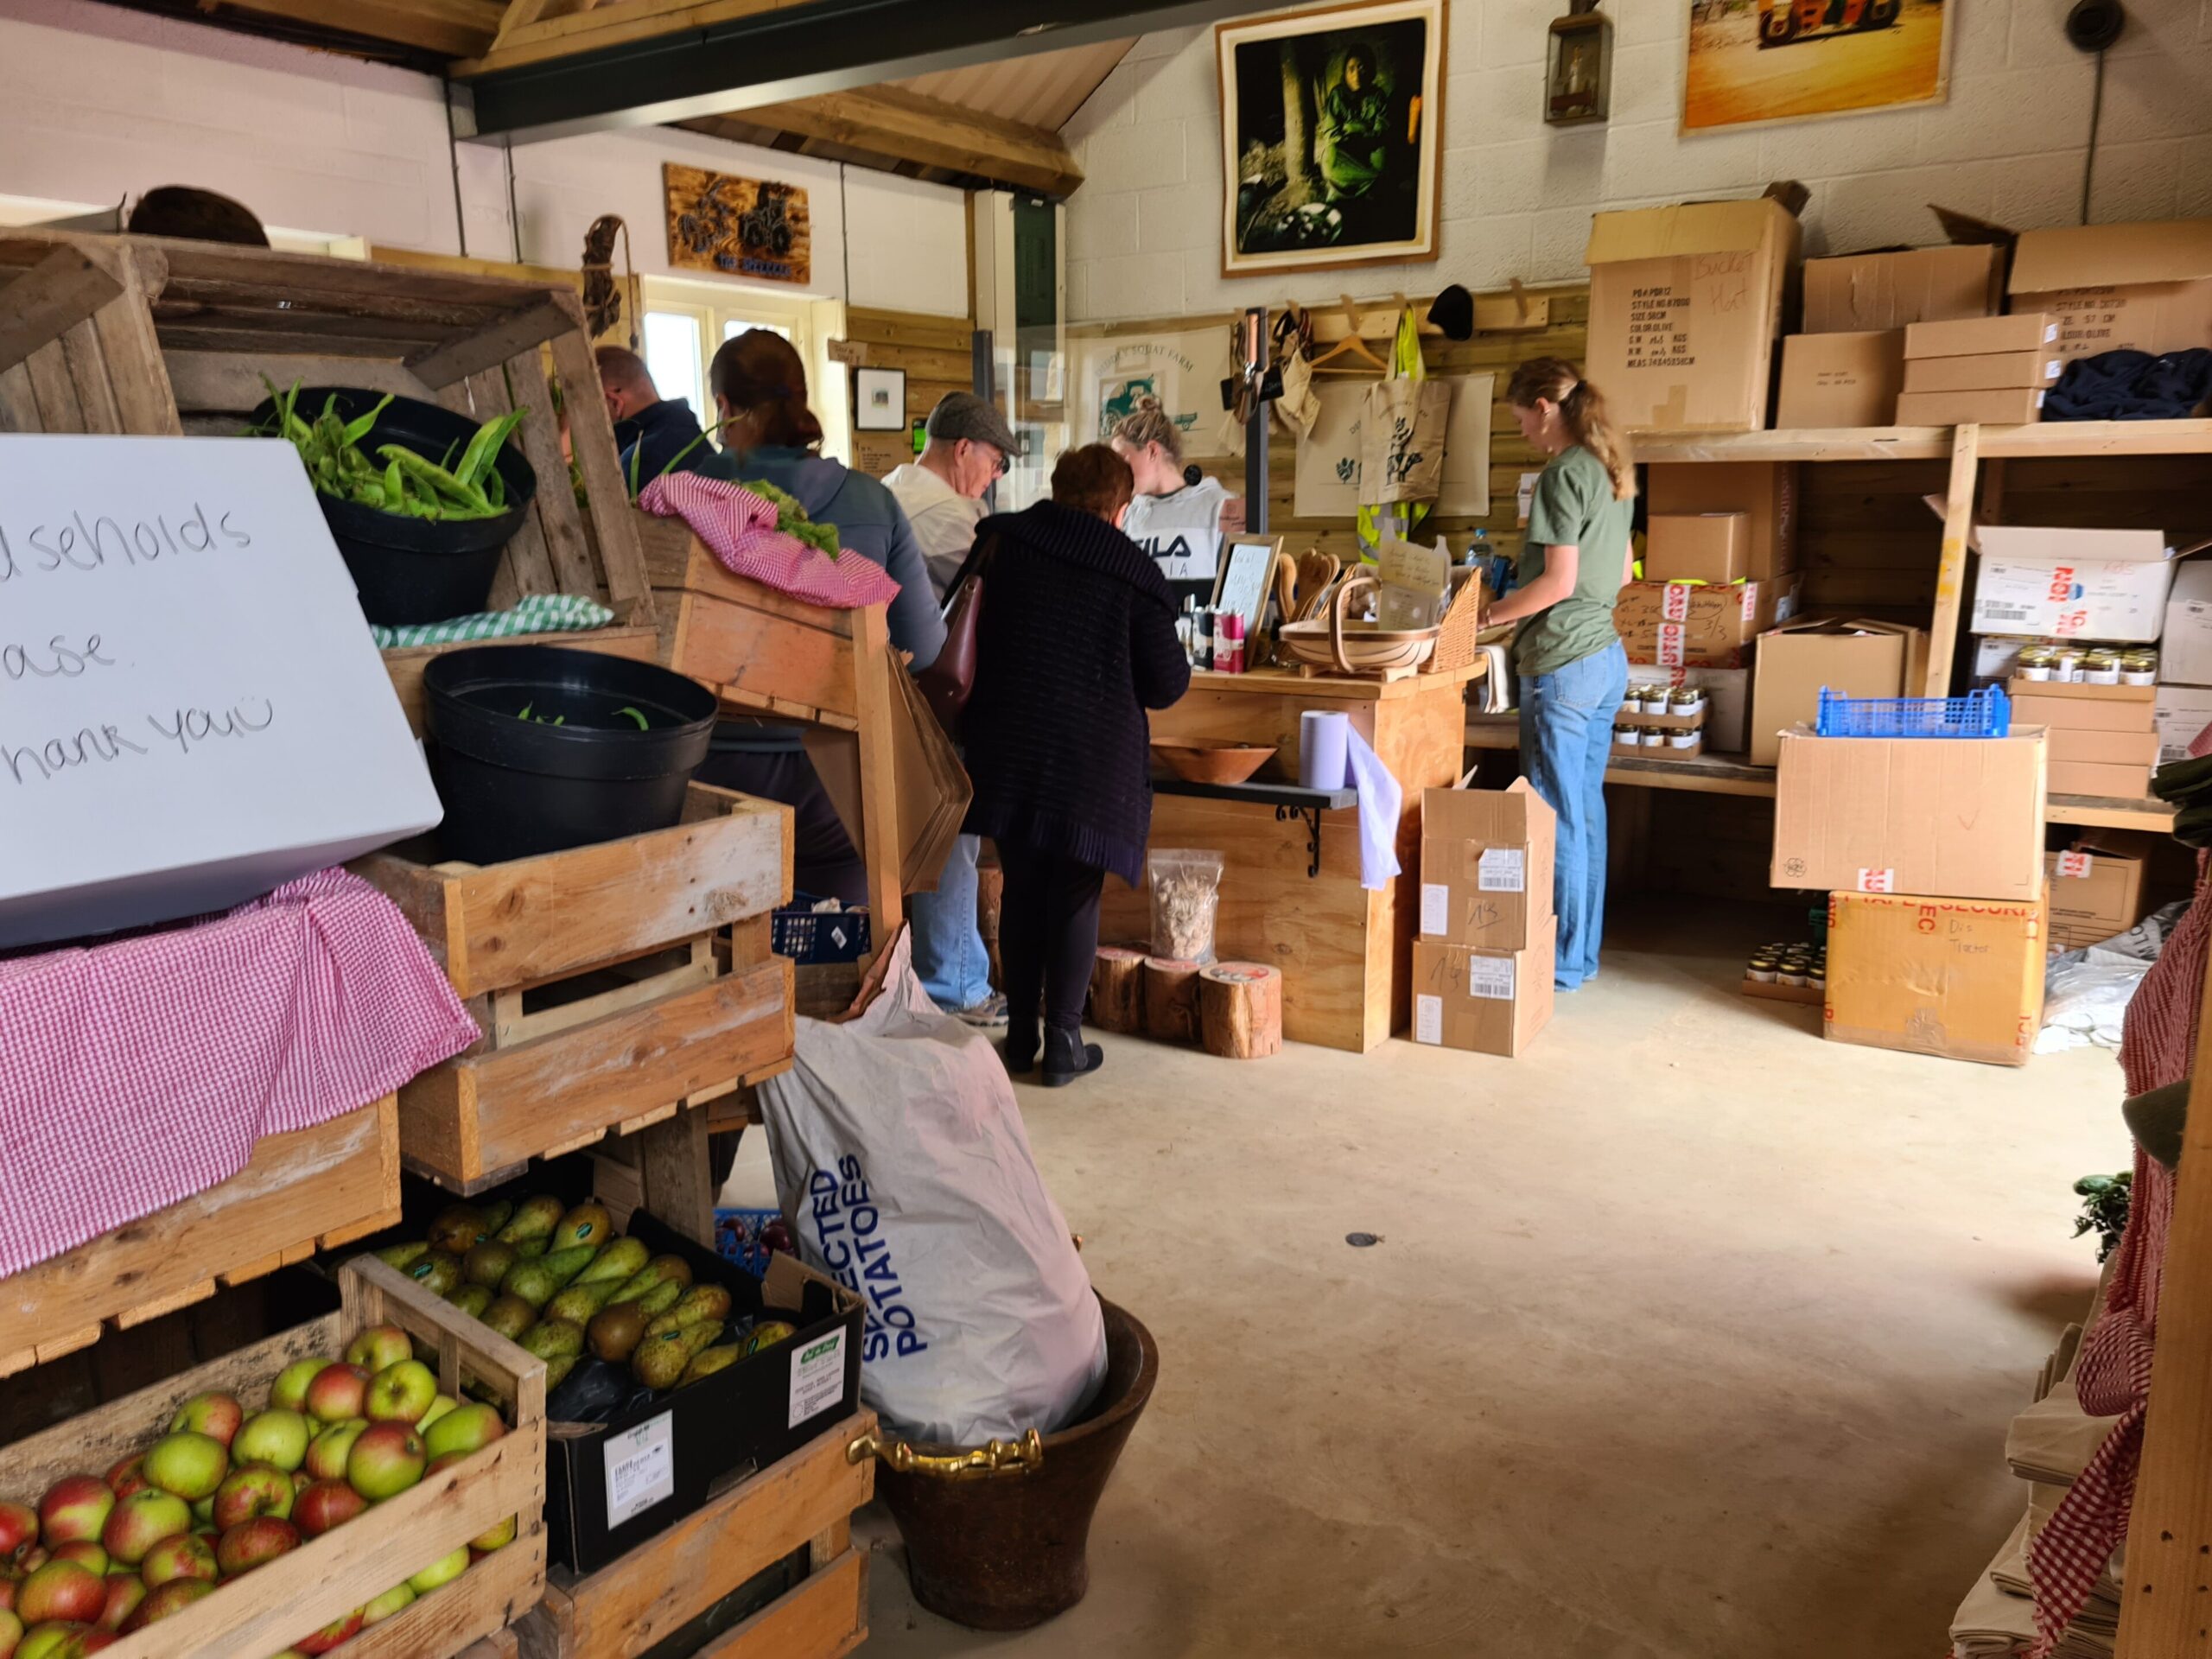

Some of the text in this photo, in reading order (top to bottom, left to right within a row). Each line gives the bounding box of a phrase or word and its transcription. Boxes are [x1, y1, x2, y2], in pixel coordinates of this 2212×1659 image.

[1167, 350, 1194, 372] FARM
[3, 633, 117, 681] ase
[1, 722, 149, 785] hank
[810, 1168, 890, 1363] SEECTED
[838, 1154, 928, 1357] POTATOES
